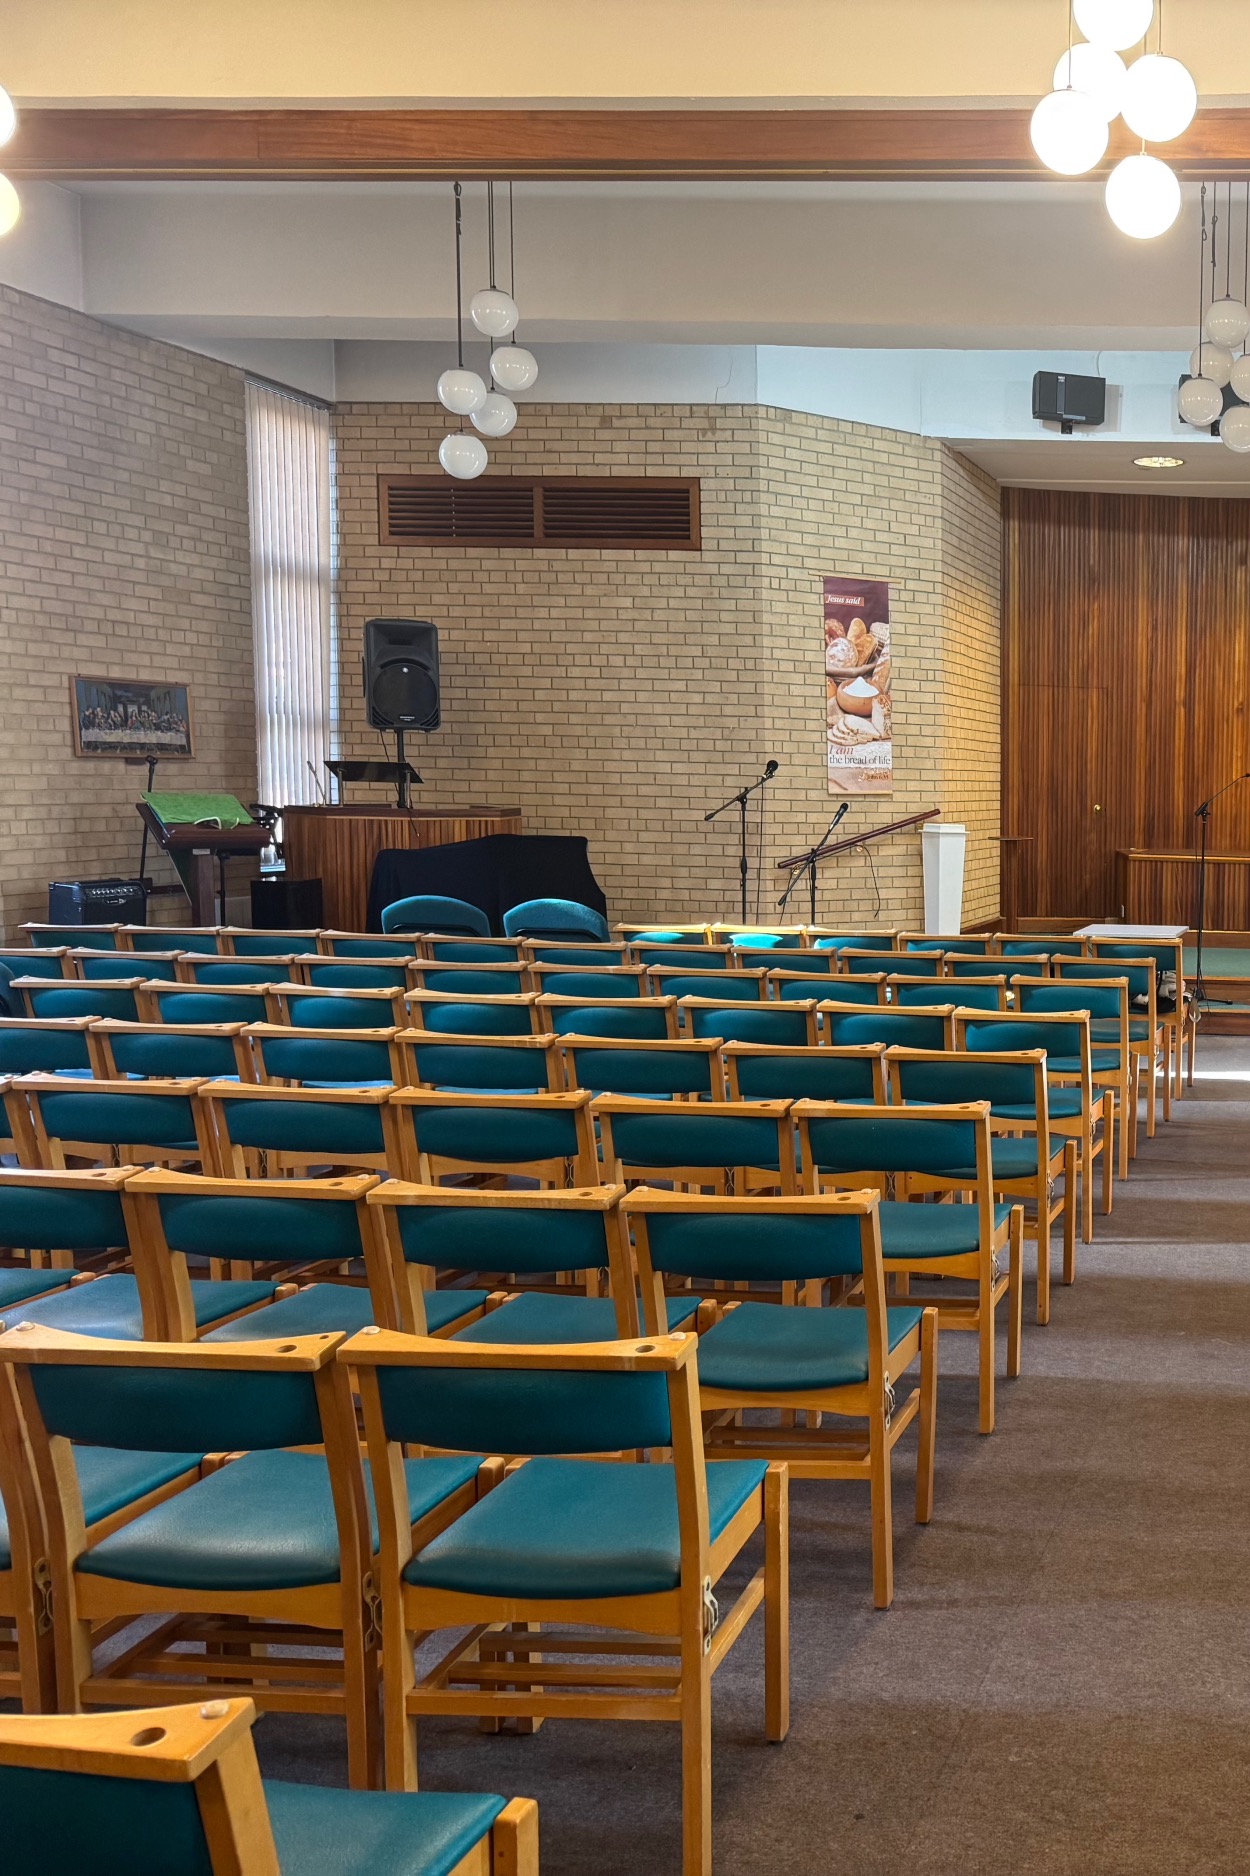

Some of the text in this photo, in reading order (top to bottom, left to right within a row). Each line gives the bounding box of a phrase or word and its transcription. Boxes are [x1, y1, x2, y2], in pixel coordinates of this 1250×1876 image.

[826, 595, 861, 605] Jesus said
[829, 745, 854, 755] I am
[829, 755, 891, 765] the bread of life
